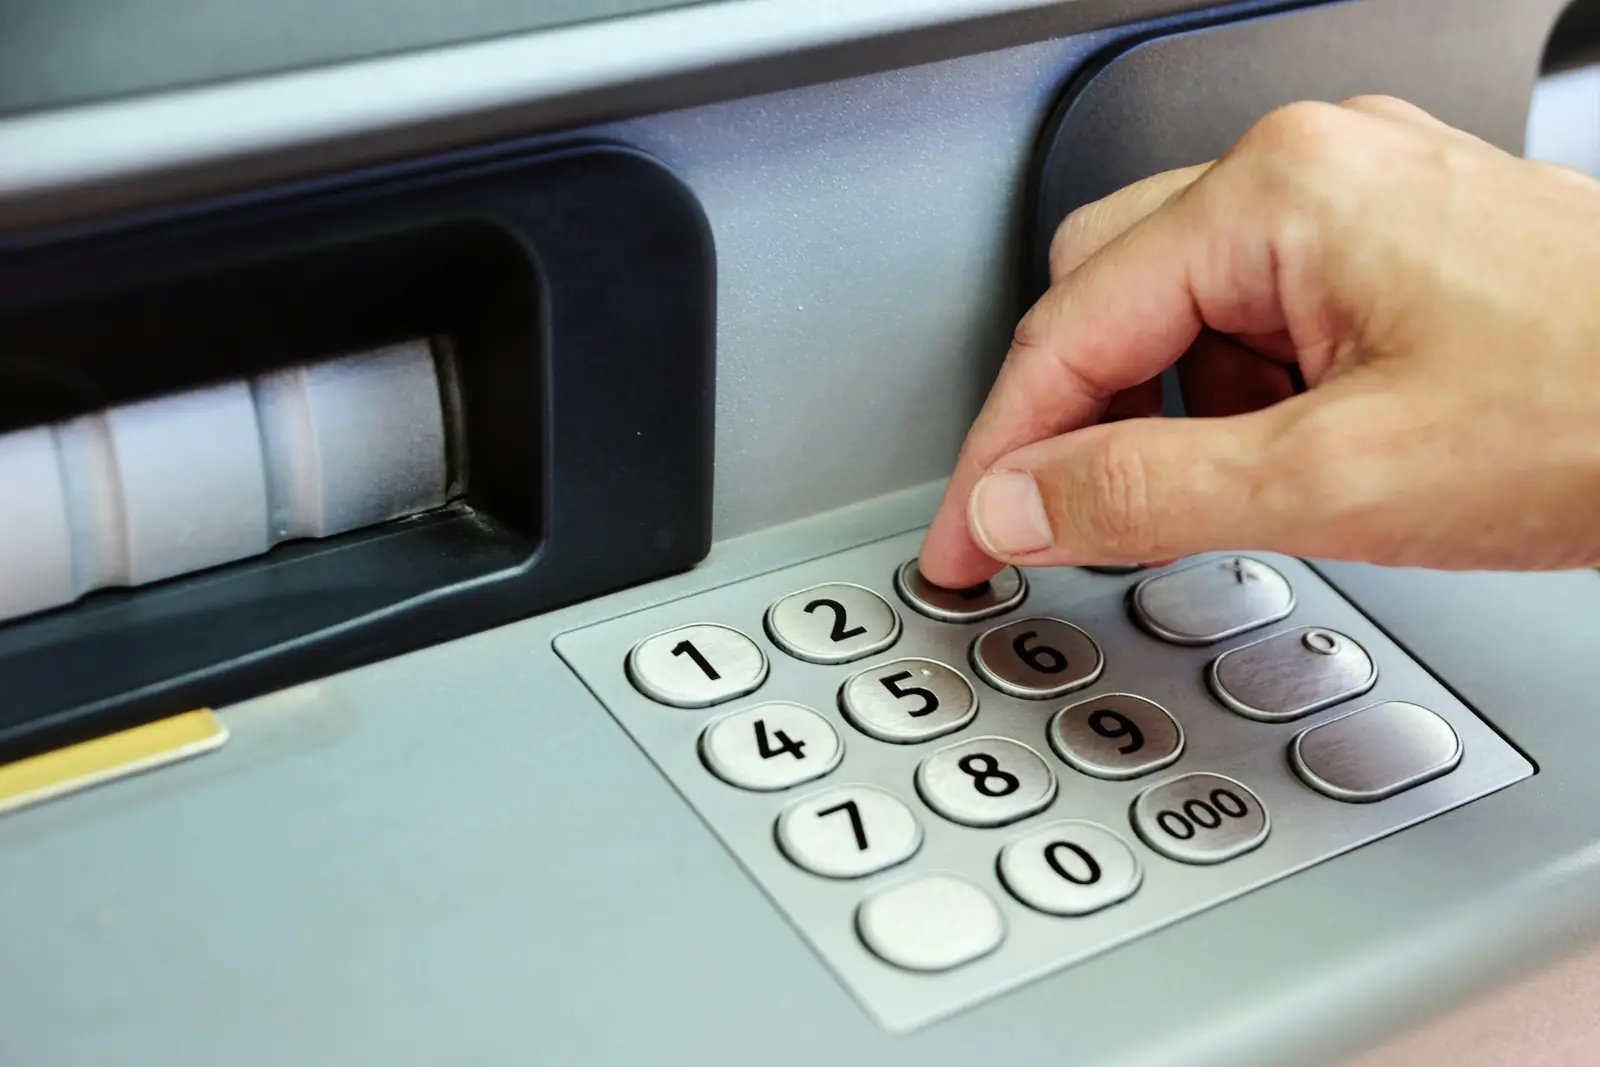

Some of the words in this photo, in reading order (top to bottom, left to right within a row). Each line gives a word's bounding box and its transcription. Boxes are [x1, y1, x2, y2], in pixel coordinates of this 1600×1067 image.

[803, 598, 867, 642] 2
[671, 640, 720, 681] 1
[1012, 631, 1068, 674] 6
[879, 670, 939, 717] 5
[753, 719, 806, 760] 4
[1087, 709, 1145, 755] 9
[958, 753, 1020, 798] 8
[817, 800, 868, 851] 7
[1156, 788, 1249, 840] 000
[1044, 841, 1101, 886] 0
